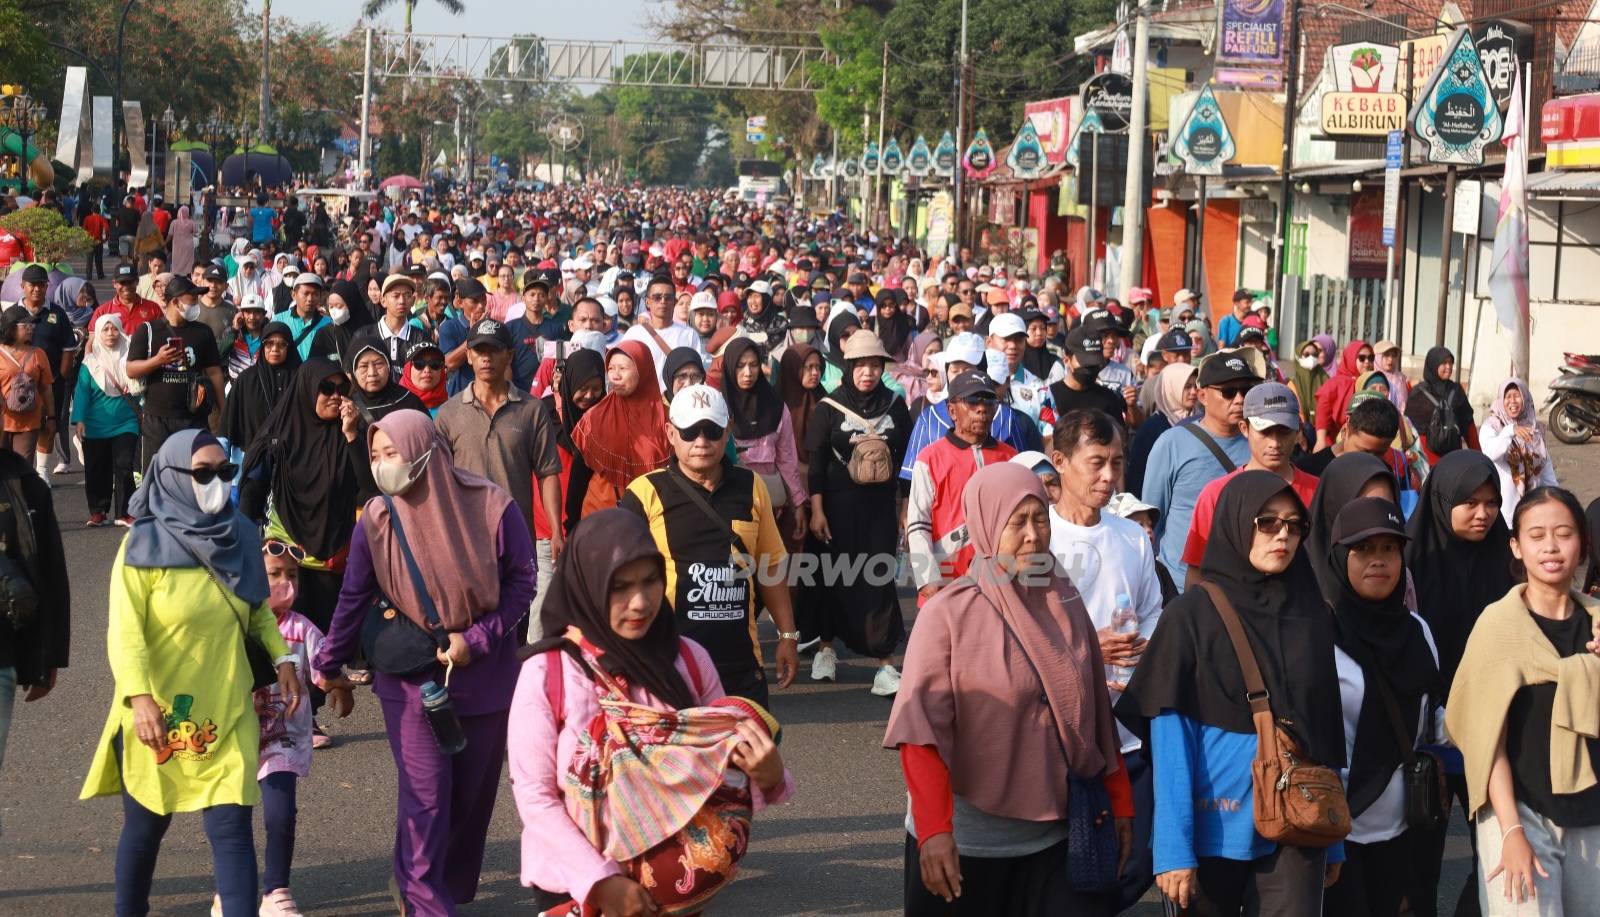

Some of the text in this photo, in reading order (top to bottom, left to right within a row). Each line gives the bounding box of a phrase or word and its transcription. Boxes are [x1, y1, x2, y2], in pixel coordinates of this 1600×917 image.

[1225, 22, 1277, 31] SPECIALIST
[1225, 30, 1276, 45] REFILL
[1224, 43, 1276, 55] PARFUME
[1334, 97, 1396, 112] KEBAB
[1327, 113, 1402, 129] ALBIRUNI
[688, 562, 734, 588] Reuni
[686, 580, 746, 602] Alumni
[708, 603, 732, 611] SULA
[691, 611, 744, 619] PURWOREJO
